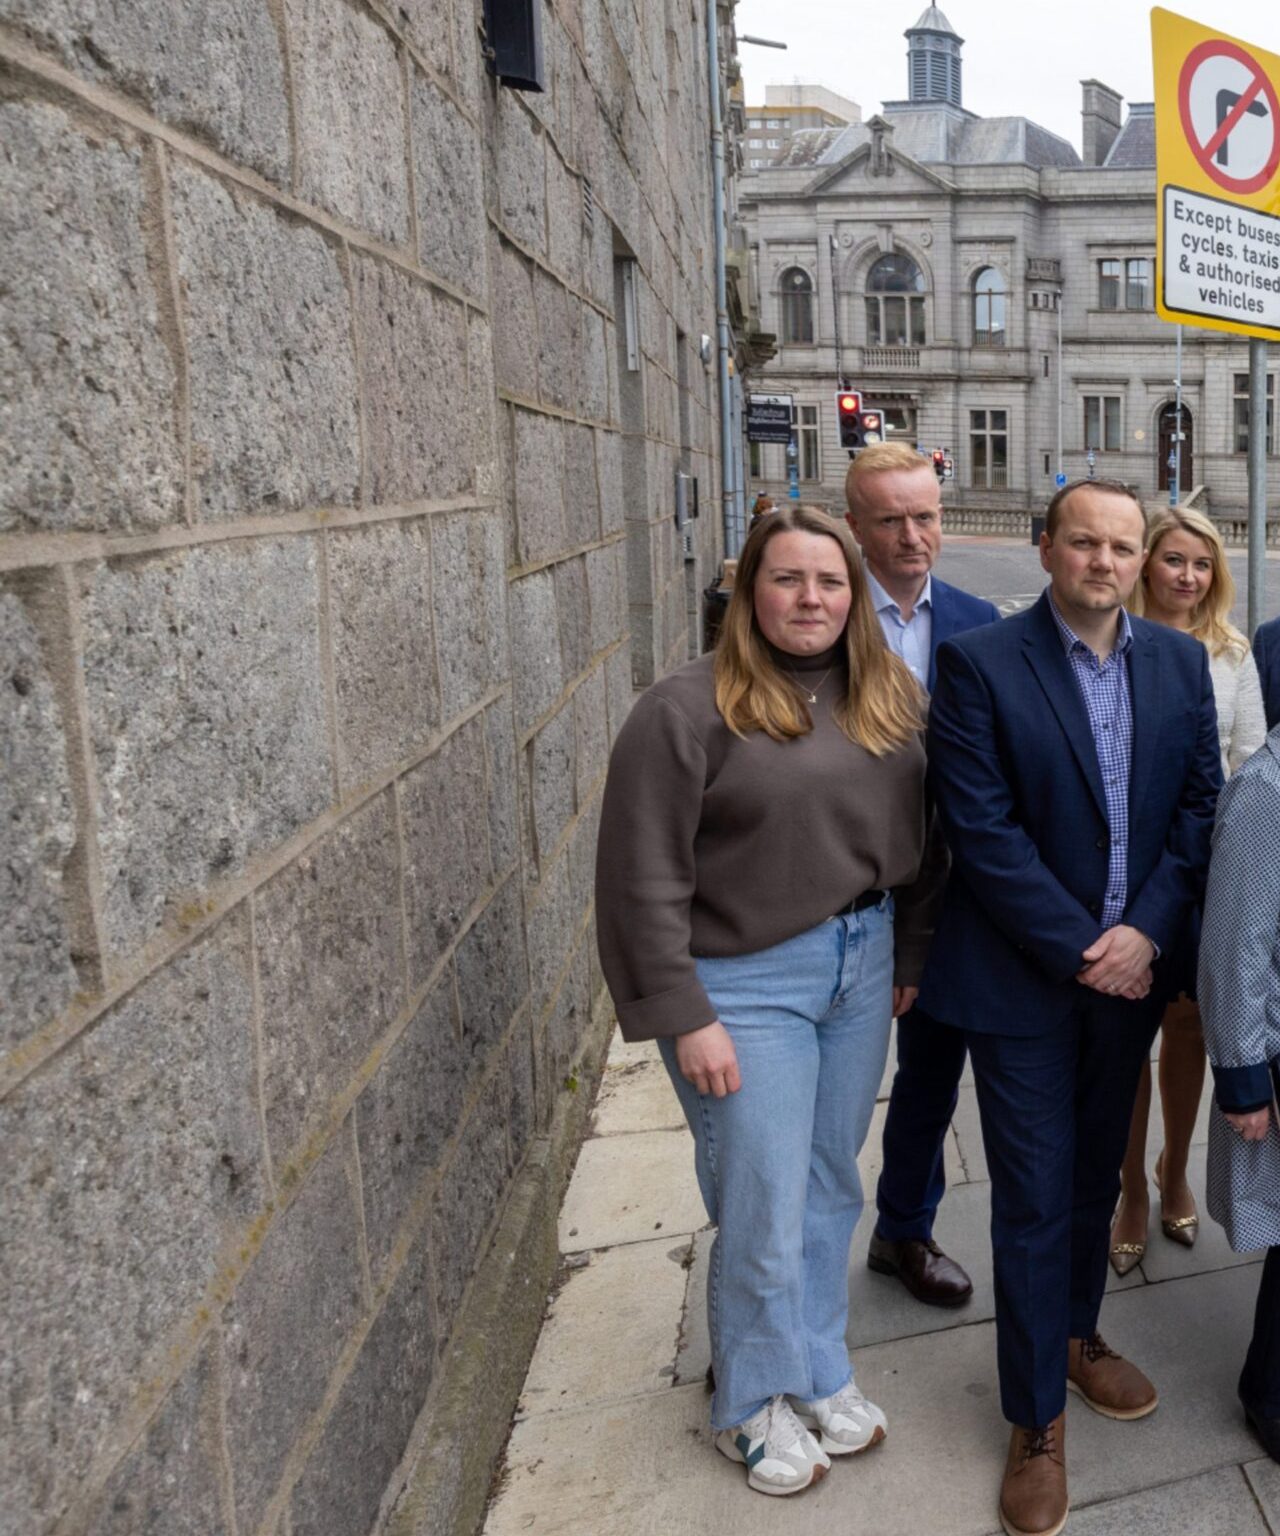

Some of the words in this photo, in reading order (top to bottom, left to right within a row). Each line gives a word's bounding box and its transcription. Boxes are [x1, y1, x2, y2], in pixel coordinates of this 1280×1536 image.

[1174, 200, 1232, 233] Except
[1243, 244, 1279, 269] taxis
[1179, 254, 1191, 274] &
[1197, 262, 1280, 293] authorised
[1199, 288, 1264, 313] vehicles
